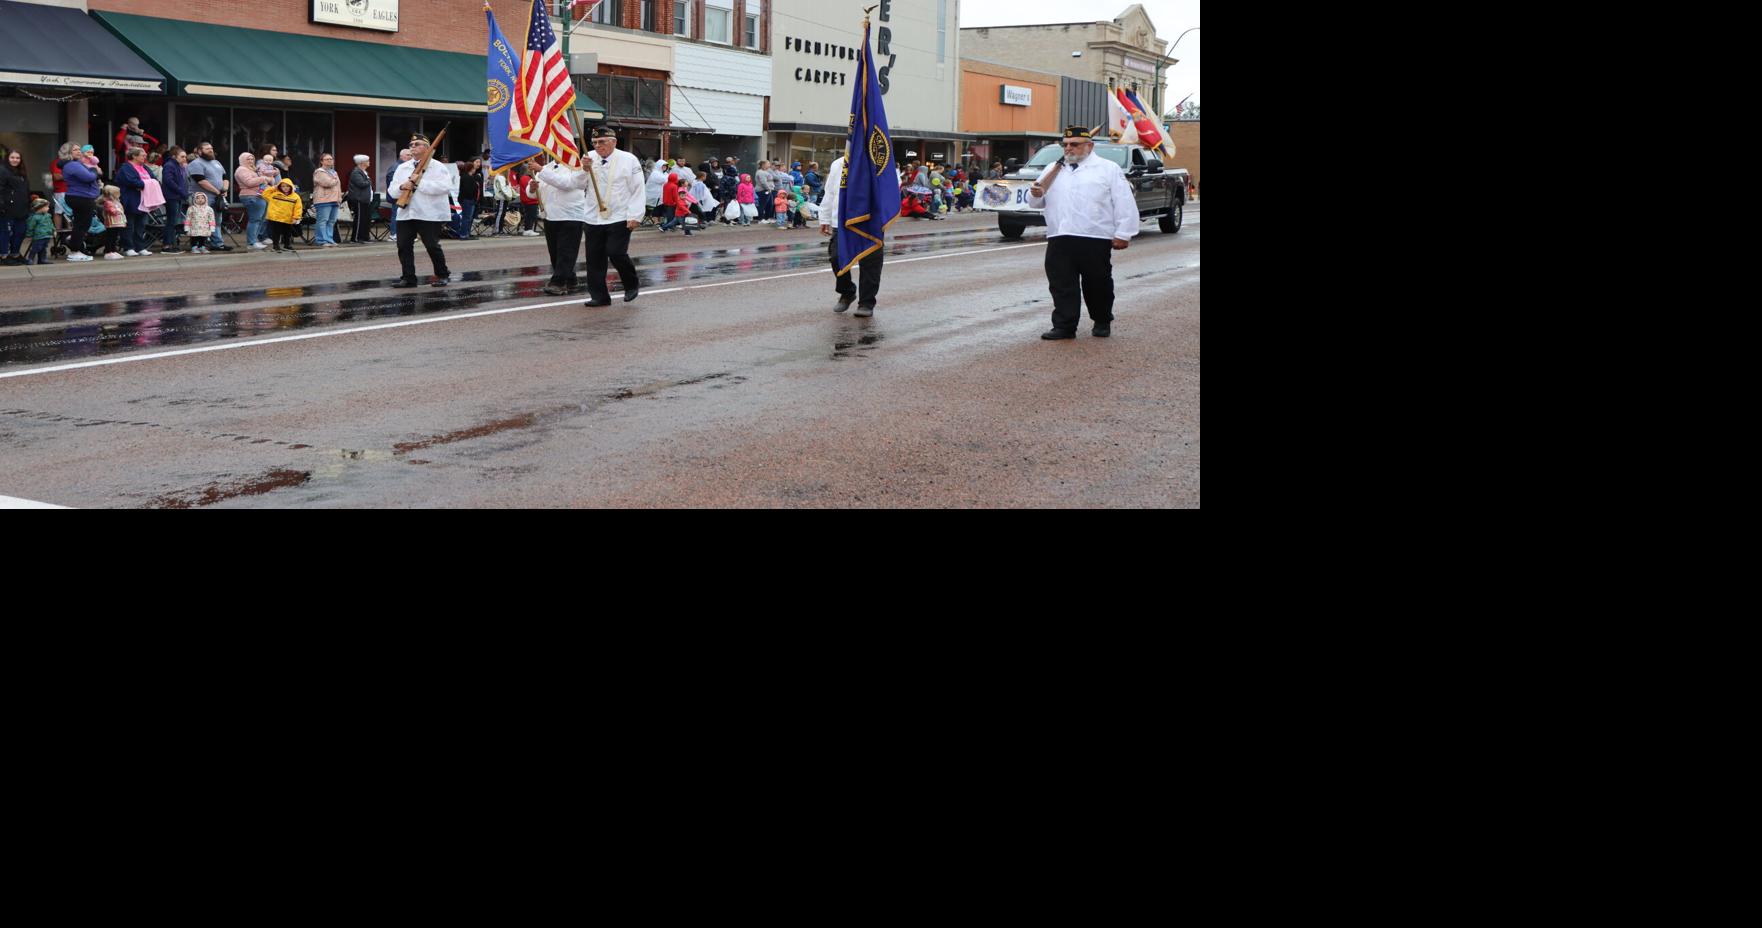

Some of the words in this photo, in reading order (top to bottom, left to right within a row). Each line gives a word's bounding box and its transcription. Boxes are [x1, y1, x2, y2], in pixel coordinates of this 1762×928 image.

[320, 1, 339, 14] YORK
[373, 9, 397, 22] EAGLES
[795, 67, 846, 86] CARPET
